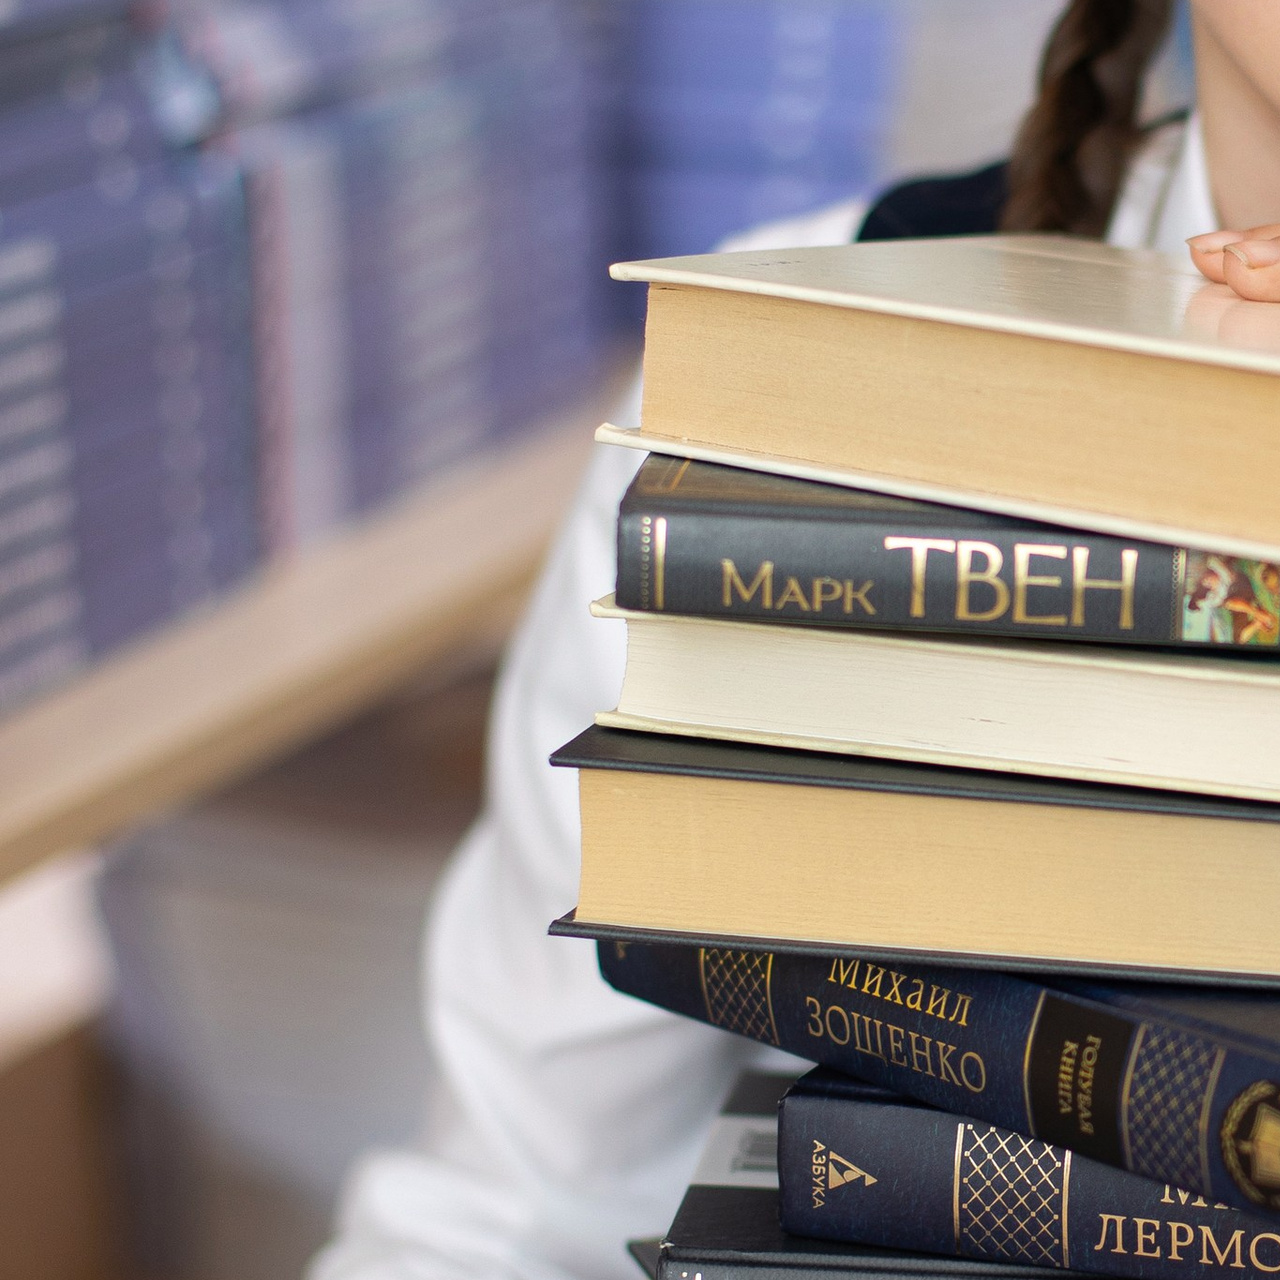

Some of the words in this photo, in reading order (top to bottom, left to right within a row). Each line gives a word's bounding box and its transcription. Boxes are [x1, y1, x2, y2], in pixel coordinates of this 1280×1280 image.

[884, 535, 1138, 630] ТВЕН
[828, 957, 973, 1027] Михаил
[806, 995, 986, 1093] ЗОЩЕНКО
[1059, 1040, 1080, 1114] КНИГА
[812, 1139, 827, 1209] АЗБУКА
